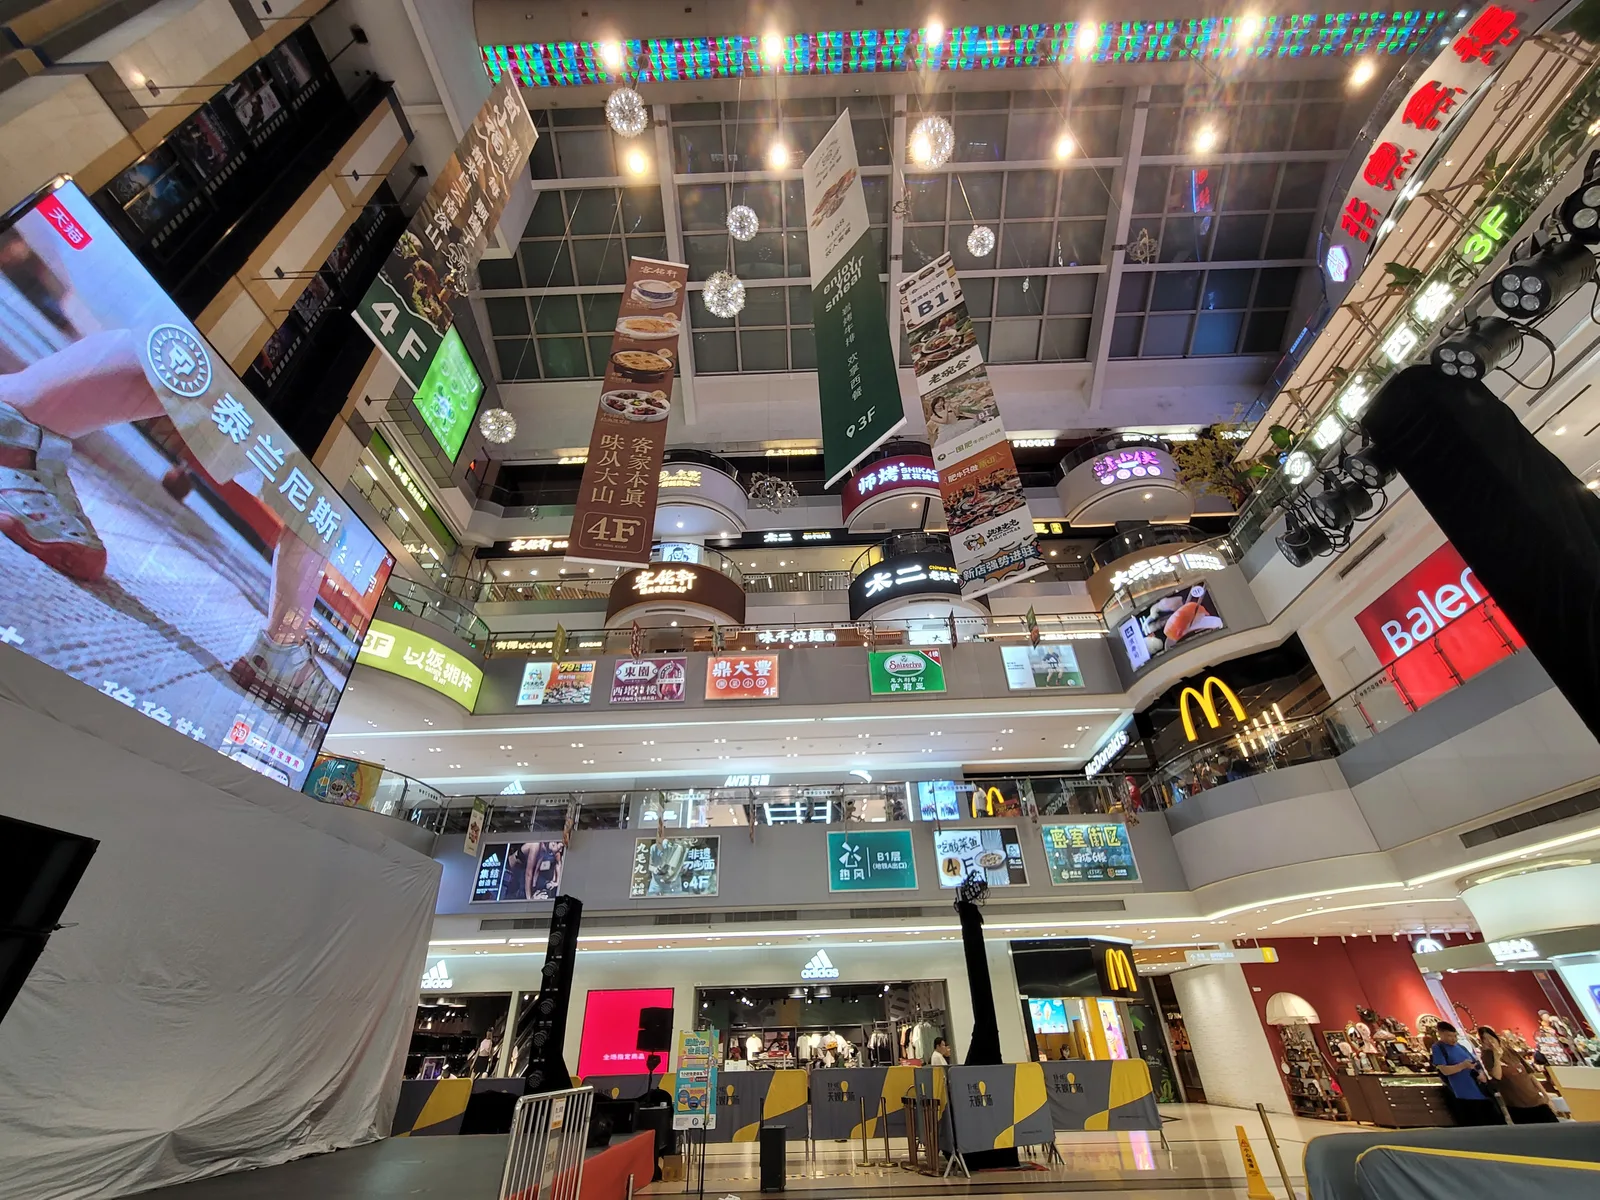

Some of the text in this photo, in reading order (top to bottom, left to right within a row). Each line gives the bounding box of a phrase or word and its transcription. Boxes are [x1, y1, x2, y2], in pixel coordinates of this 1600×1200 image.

[424, 144, 487, 251] 都来自云南深山
[48, 206, 84, 246] 天猫
[1463, 204, 1509, 263] 3F
[823, 255, 857, 296] enjoy
[835, 254, 865, 294] your
[917, 291, 949, 318] B1
[371, 302, 427, 362] 4F
[858, 406, 877, 432] 3F
[1012, 439, 1056, 448] FROGGY
[210, 392, 342, 543] 泰兰尼斯
[591, 434, 625, 505] 味从大山
[587, 517, 641, 543] 4F
[962, 545, 1037, 581] 新店强势进驻
[763, 688, 777, 696] 4F
[1085, 729, 1130, 781] McDonald's
[723, 775, 750, 787] ANTA
[937, 836, 980, 856] 吃酸菜鱼
[1050, 826, 1121, 849] 密室街区
[633, 842, 649, 874] 九毛九
[876, 851, 902, 862] B1层
[689, 875, 711, 889] 4F
[839, 868, 865, 881] 热风
[801, 967, 840, 980] adidas
